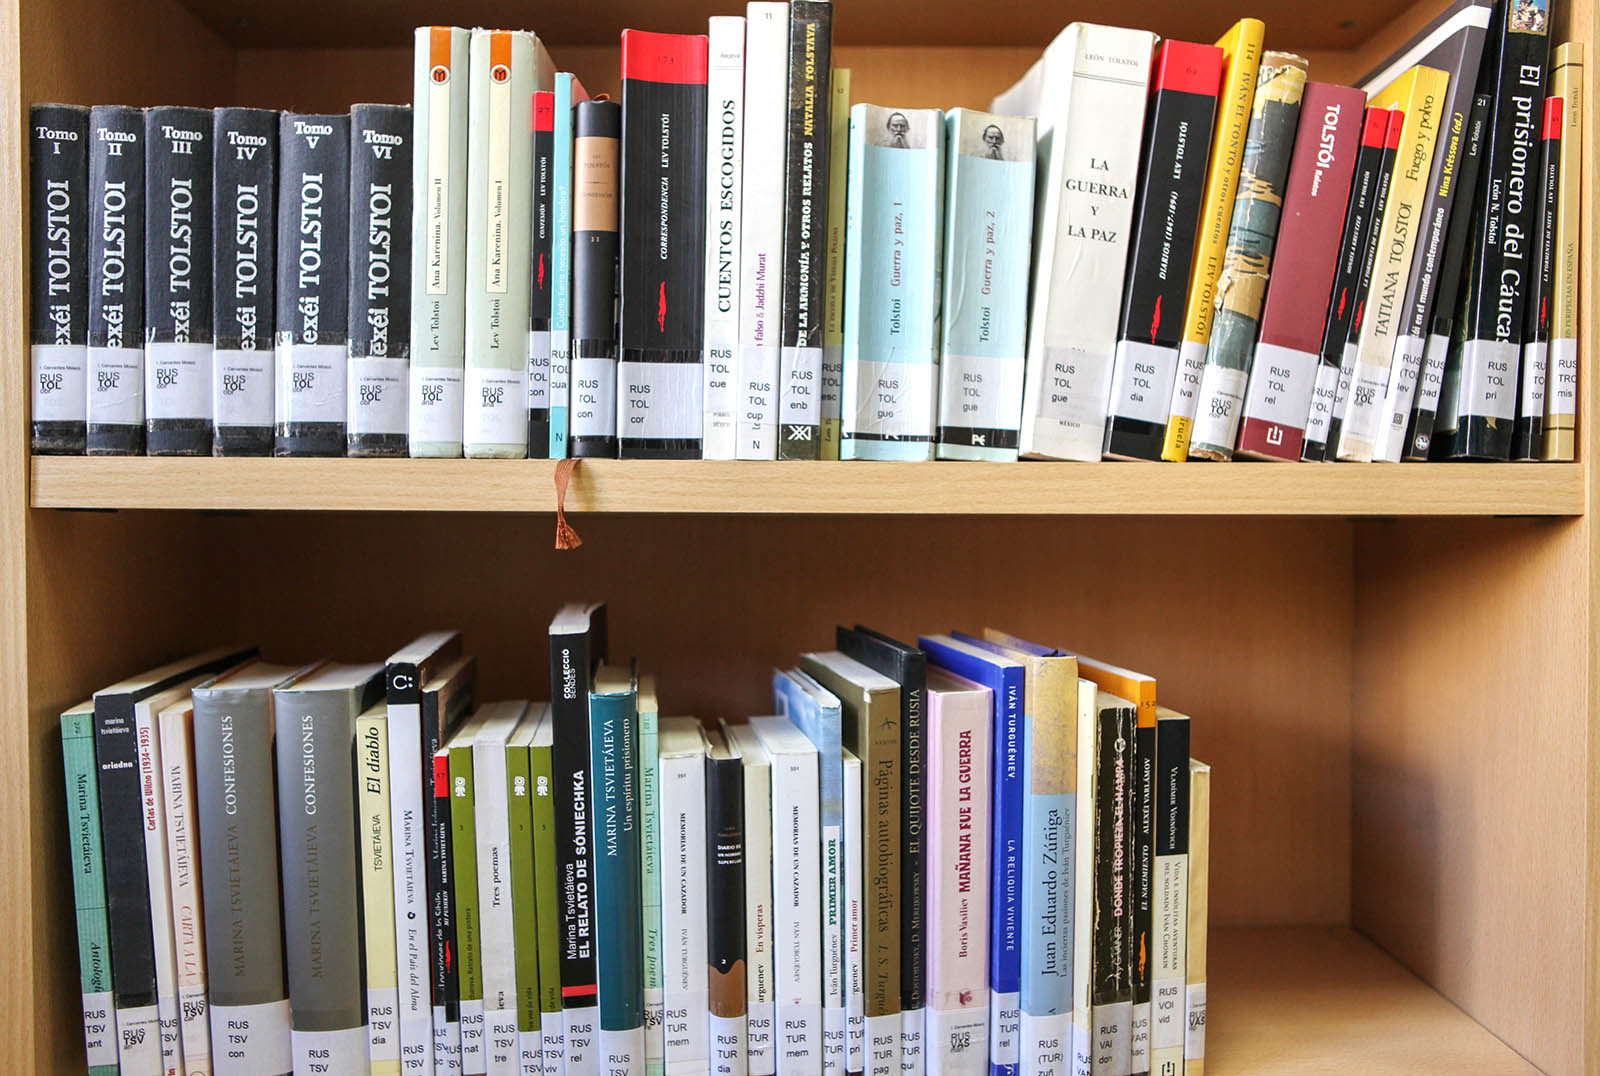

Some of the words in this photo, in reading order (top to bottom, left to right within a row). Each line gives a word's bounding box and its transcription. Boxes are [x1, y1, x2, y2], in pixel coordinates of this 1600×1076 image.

[806, 23, 815, 82] TOLSTAYA
[1519, 65, 1541, 87] El
[804, 85, 814, 136] NATALIA
[1416, 95, 1434, 130] polvo
[1477, 98, 1486, 106] 21
[36, 127, 78, 142] Tomo
[97, 128, 136, 142] Tomo
[162, 125, 202, 141] Tomo
[294, 121, 332, 135] Tomo
[363, 130, 402, 146] Tomo
[1316, 104, 1341, 169] TOLSTÓI
[1417, 131, 1429, 140] y
[1452, 112, 1465, 135] (ed.)
[53, 142, 60, 154] I
[108, 144, 122, 156] II
[172, 141, 192, 154] III
[228, 132, 266, 147] Tomo
[237, 147, 257, 160] IV
[306, 135, 319, 148] V
[372, 146, 392, 159] VI
[1176, 121, 1188, 160] TOLSTÓI
[1226, 122, 1242, 166] TONTO
[720, 100, 735, 211] ESCOGIDOS
[803, 142, 813, 196] RELATOS
[1091, 158, 1109, 171] LA
[1173, 161, 1183, 179] LEV
[1404, 144, 1427, 182] Fuego
[1443, 136, 1460, 175] Kréssova
[1507, 96, 1535, 214] prisionero
[1066, 178, 1128, 199] GUERRA
[1311, 170, 1323, 197] Relatos
[1438, 176, 1452, 198] Nina
[1492, 180, 1502, 200] León
[660, 176, 669, 260] CORRESPONDENCIA
[801, 199, 810, 239] OTROS
[1091, 206, 1099, 216] Y
[1165, 191, 1178, 240] (1847-1894)
[1491, 202, 1499, 213] N.
[48, 179, 70, 295] TOLSTOI
[103, 181, 126, 296] TOLSTOI
[170, 178, 192, 292] TOLSTOI
[236, 184, 258, 298] TOLSTOI
[299, 173, 323, 289] TOLSTOI
[368, 183, 391, 299] TOLSTOI
[1068, 225, 1087, 236] LA
[1092, 231, 1117, 243] PAZ
[1388, 202, 1412, 264] TOLSTOI
[1424, 208, 1445, 272] contemporáneo
[1488, 214, 1499, 245] Tolstoi
[1504, 224, 1525, 260] del
[718, 220, 733, 312] CUENTOS
[1158, 242, 1170, 280] DIARIOS
[982, 259, 993, 296] Guerra
[1418, 274, 1432, 304] mundo
[431, 301, 439, 331] Tolstoi
[491, 299, 500, 329] Tolstoi
[1374, 271, 1400, 337] TATIANA
[980, 306, 991, 342] Tolstoi
[431, 337, 439, 351] Lev
[491, 334, 499, 349] Lev
[1270, 366, 1290, 378] RUS
[1488, 361, 1507, 371] RUS
[1488, 376, 1504, 386] TOL
[1268, 381, 1286, 392] TOL
[556, 433, 562, 441] N
[753, 441, 760, 449] N
[910, 689, 920, 728] RUSIA
[1008, 685, 1016, 709] IVÁN
[365, 727, 380, 773] diablo
[621, 718, 634, 770] prisionero
[910, 731, 920, 775] DESDE
[959, 730, 972, 784] GUERRA
[1008, 714, 1016, 778] TURGUÉNIEV
[103, 761, 133, 770] ariadna
[221, 715, 237, 815] CONFESIONES
[302, 715, 317, 815] CONFESIONES
[602, 720, 616, 802] TSVIETÁIEVA
[77, 774, 90, 811] Marina
[171, 766, 184, 810] MARINA
[367, 781, 381, 794] El
[622, 773, 634, 812] espíritu
[644, 768, 655, 806] Marina
[960, 786, 971, 802] LA
[1114, 759, 1124, 800] HAMPA
[572, 770, 586, 855] SÓNIECHKA
[909, 778, 921, 837] QUIJOTE
[960, 806, 972, 830] FUE
[1114, 802, 1124, 816] EL
[606, 805, 618, 856] MARINA
[623, 815, 634, 831] Un
[792, 805, 800, 845] MEMORIAS
[1043, 809, 1062, 864] Zúñiga
[80, 813, 93, 874] Tsvietáieva
[174, 812, 190, 887] TSVIETÁIEVA
[369, 814, 383, 872] TSVIETÁIEVA
[828, 838, 837, 874] AMOR
[910, 839, 919, 853] EL
[1007, 840, 1015, 852] LA
[1113, 820, 1124, 872] TROPIEZA
[490, 847, 502, 884] poemas
[576, 860, 588, 878] DE
[955, 834, 972, 893] MAÑANA
[1141, 845, 1149, 898] NACIMIENTO
[564, 864, 576, 922] Tsvietáieva
[1007, 856, 1016, 903] RELIQUIA
[492, 886, 502, 908] Tres
[577, 882, 590, 937] RELATO
[828, 876, 838, 926] PRIMER
[1042, 870, 1058, 936] Eduardo
[1113, 875, 1124, 916] DONDE
[181, 906, 194, 944] CARTA
[1006, 906, 1015, 952] VIVIENTE
[311, 920, 323, 979] MARINA
[566, 924, 578, 960] Marina
[578, 940, 590, 958] EL
[959, 933, 968, 958] Boris
[1042, 942, 1060, 976] Juan
[830, 978, 838, 996] Iván
[1159, 987, 1177, 996] RUS
[228, 1021, 249, 1029] RUS
[371, 1007, 392, 1015] RUS
[372, 1021, 391, 1030] TSV
[666, 1009, 687, 1018] RUS
[785, 1020, 806, 1029] RUS
[86, 1025, 105, 1033] TSV
[228, 1035, 248, 1043] TSV
[494, 1025, 515, 1033] RUS
[495, 1039, 514, 1047] TSV
[571, 1025, 592, 1033] RUS
[667, 1024, 687, 1032] TUR
[717, 1036, 738, 1044] RUS
[786, 1034, 806, 1043] TUR
[874, 1036, 893, 1046] RUS
[309, 1050, 329, 1058] RUS
[403, 1045, 424, 1054] RUS
[571, 1039, 591, 1048] TSV
[718, 1050, 738, 1059] TUR
[874, 1051, 892, 1060] TUR
[1038, 1040, 1058, 1049] RUS
[609, 1055, 630, 1063] RUS
